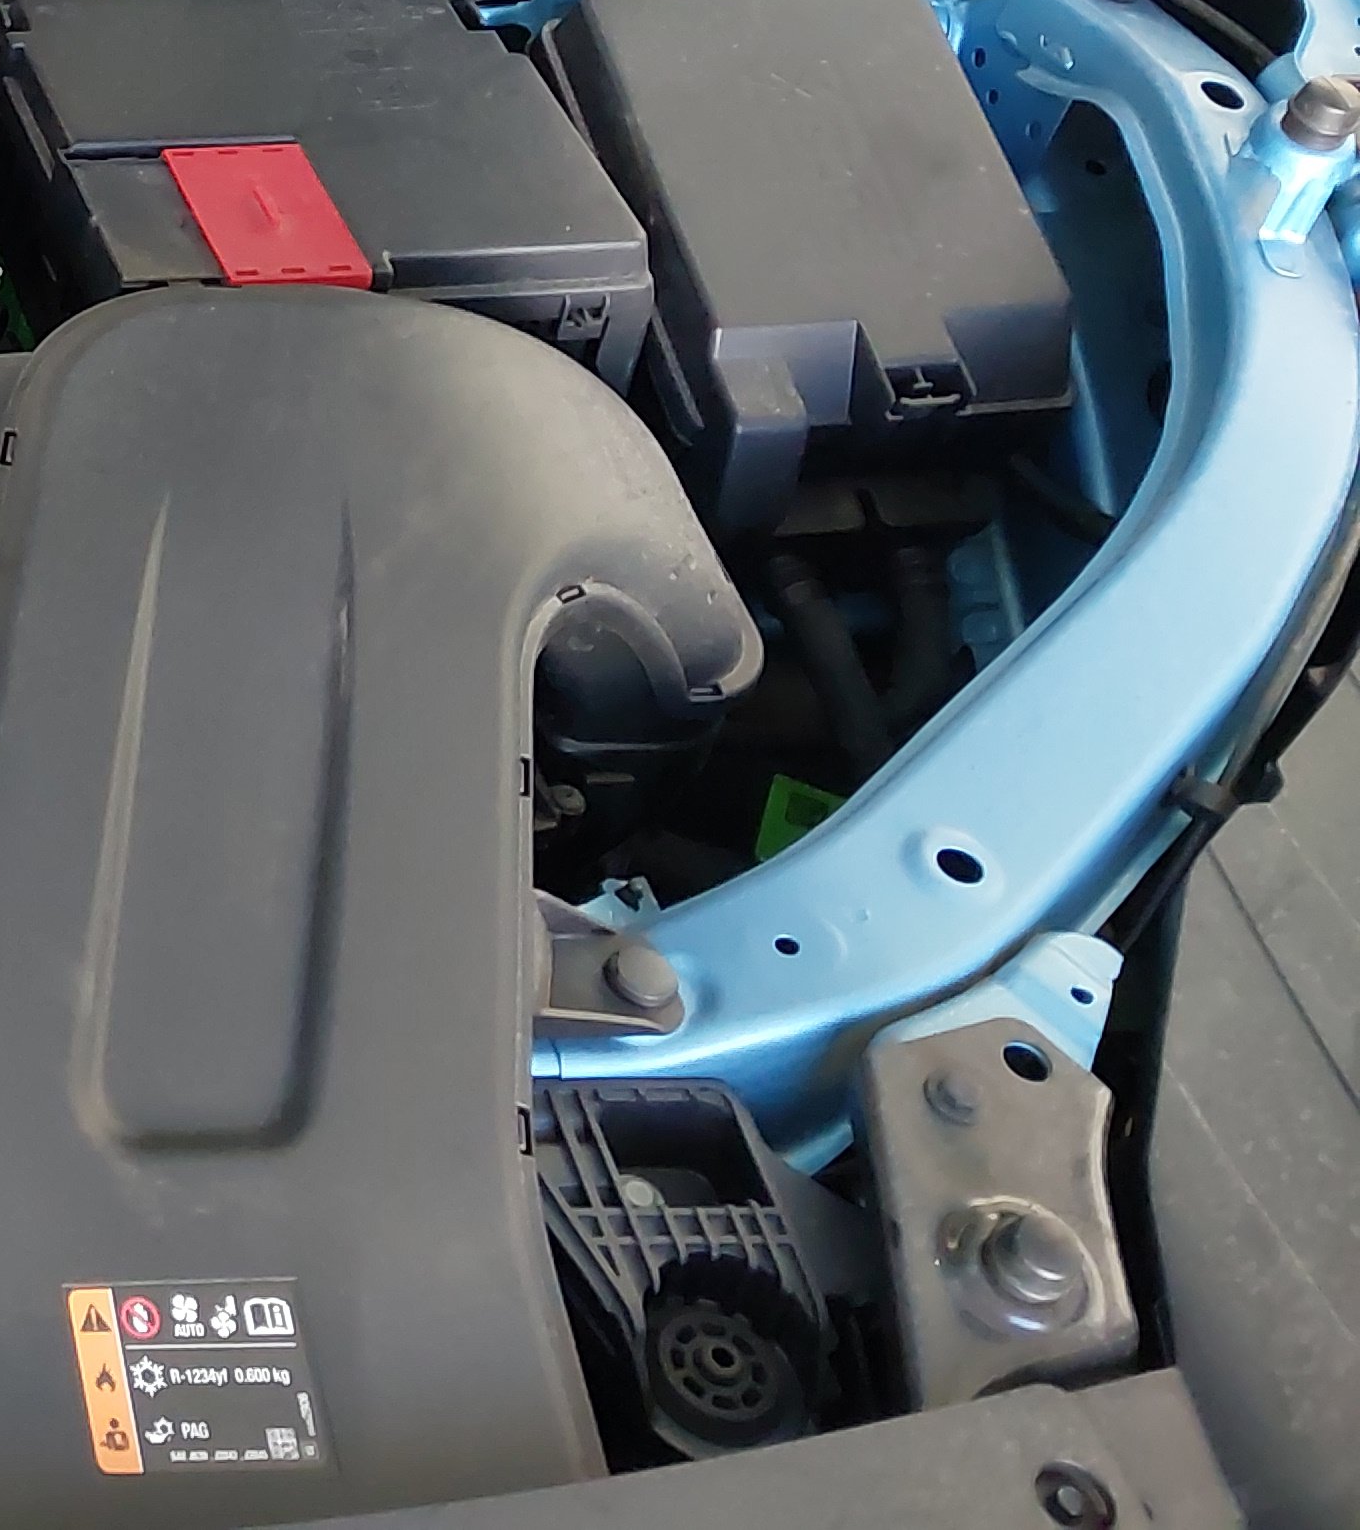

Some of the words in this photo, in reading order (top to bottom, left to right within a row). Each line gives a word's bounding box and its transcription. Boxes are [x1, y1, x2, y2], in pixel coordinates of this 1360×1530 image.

[174, 1323, 206, 1337] AUTO
[272, 1366, 291, 1386] kg
[180, 1421, 210, 1439] PAG
